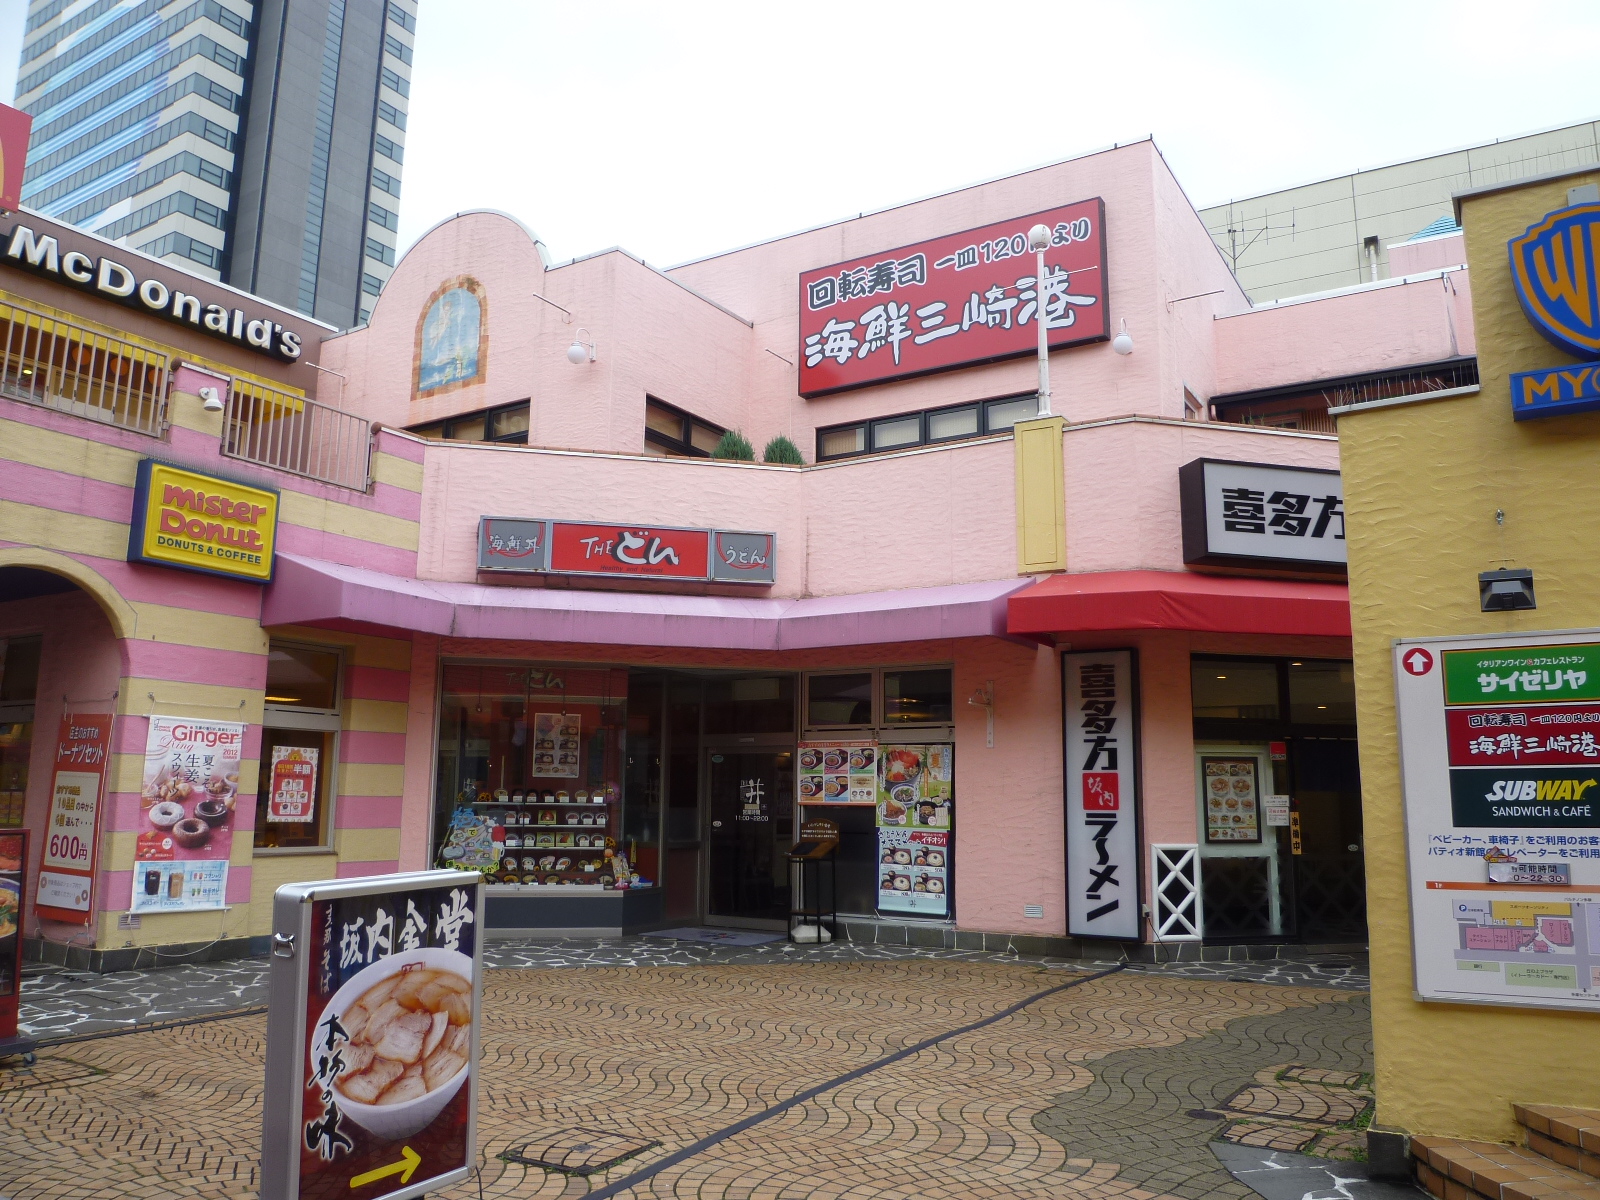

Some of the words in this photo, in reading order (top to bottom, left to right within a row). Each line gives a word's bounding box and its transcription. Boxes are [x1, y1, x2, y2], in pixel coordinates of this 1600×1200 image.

[808, 253, 926, 311] 回転寿司
[934, 217, 1091, 270] 一皿120より
[7, 224, 301, 359] McDonald's
[805, 264, 1097, 365] 海鮮三崎港
[160, 508, 263, 550] Donut
[158, 536, 204, 553] DONUTS
[206, 546, 214, 554] &
[217, 548, 261, 564] COFFEE
[489, 535, 539, 554] 海鮮丼
[580, 537, 612, 559] THE
[613, 531, 680, 566] どん
[726, 545, 766, 565] うどん
[1477, 669, 1587, 692] サイゼリヤ
[1080, 664, 1118, 771] 喜多方
[1468, 713, 1527, 728] 回転寿司
[172, 724, 240, 748] Ginger
[1469, 732, 1600, 759] 海鮮三崎港
[58, 742, 104, 764] ドーナツセット
[184, 754, 200, 784] 生姜
[1087, 777, 1114, 807] 坂内
[1486, 779, 1597, 801] SUBWAY
[1492, 806, 1551, 817] SANDWICH
[1562, 805, 1591, 817] CAFÉ
[50, 834, 88, 861] 600円
[1083, 813, 1120, 922] ラーメン
